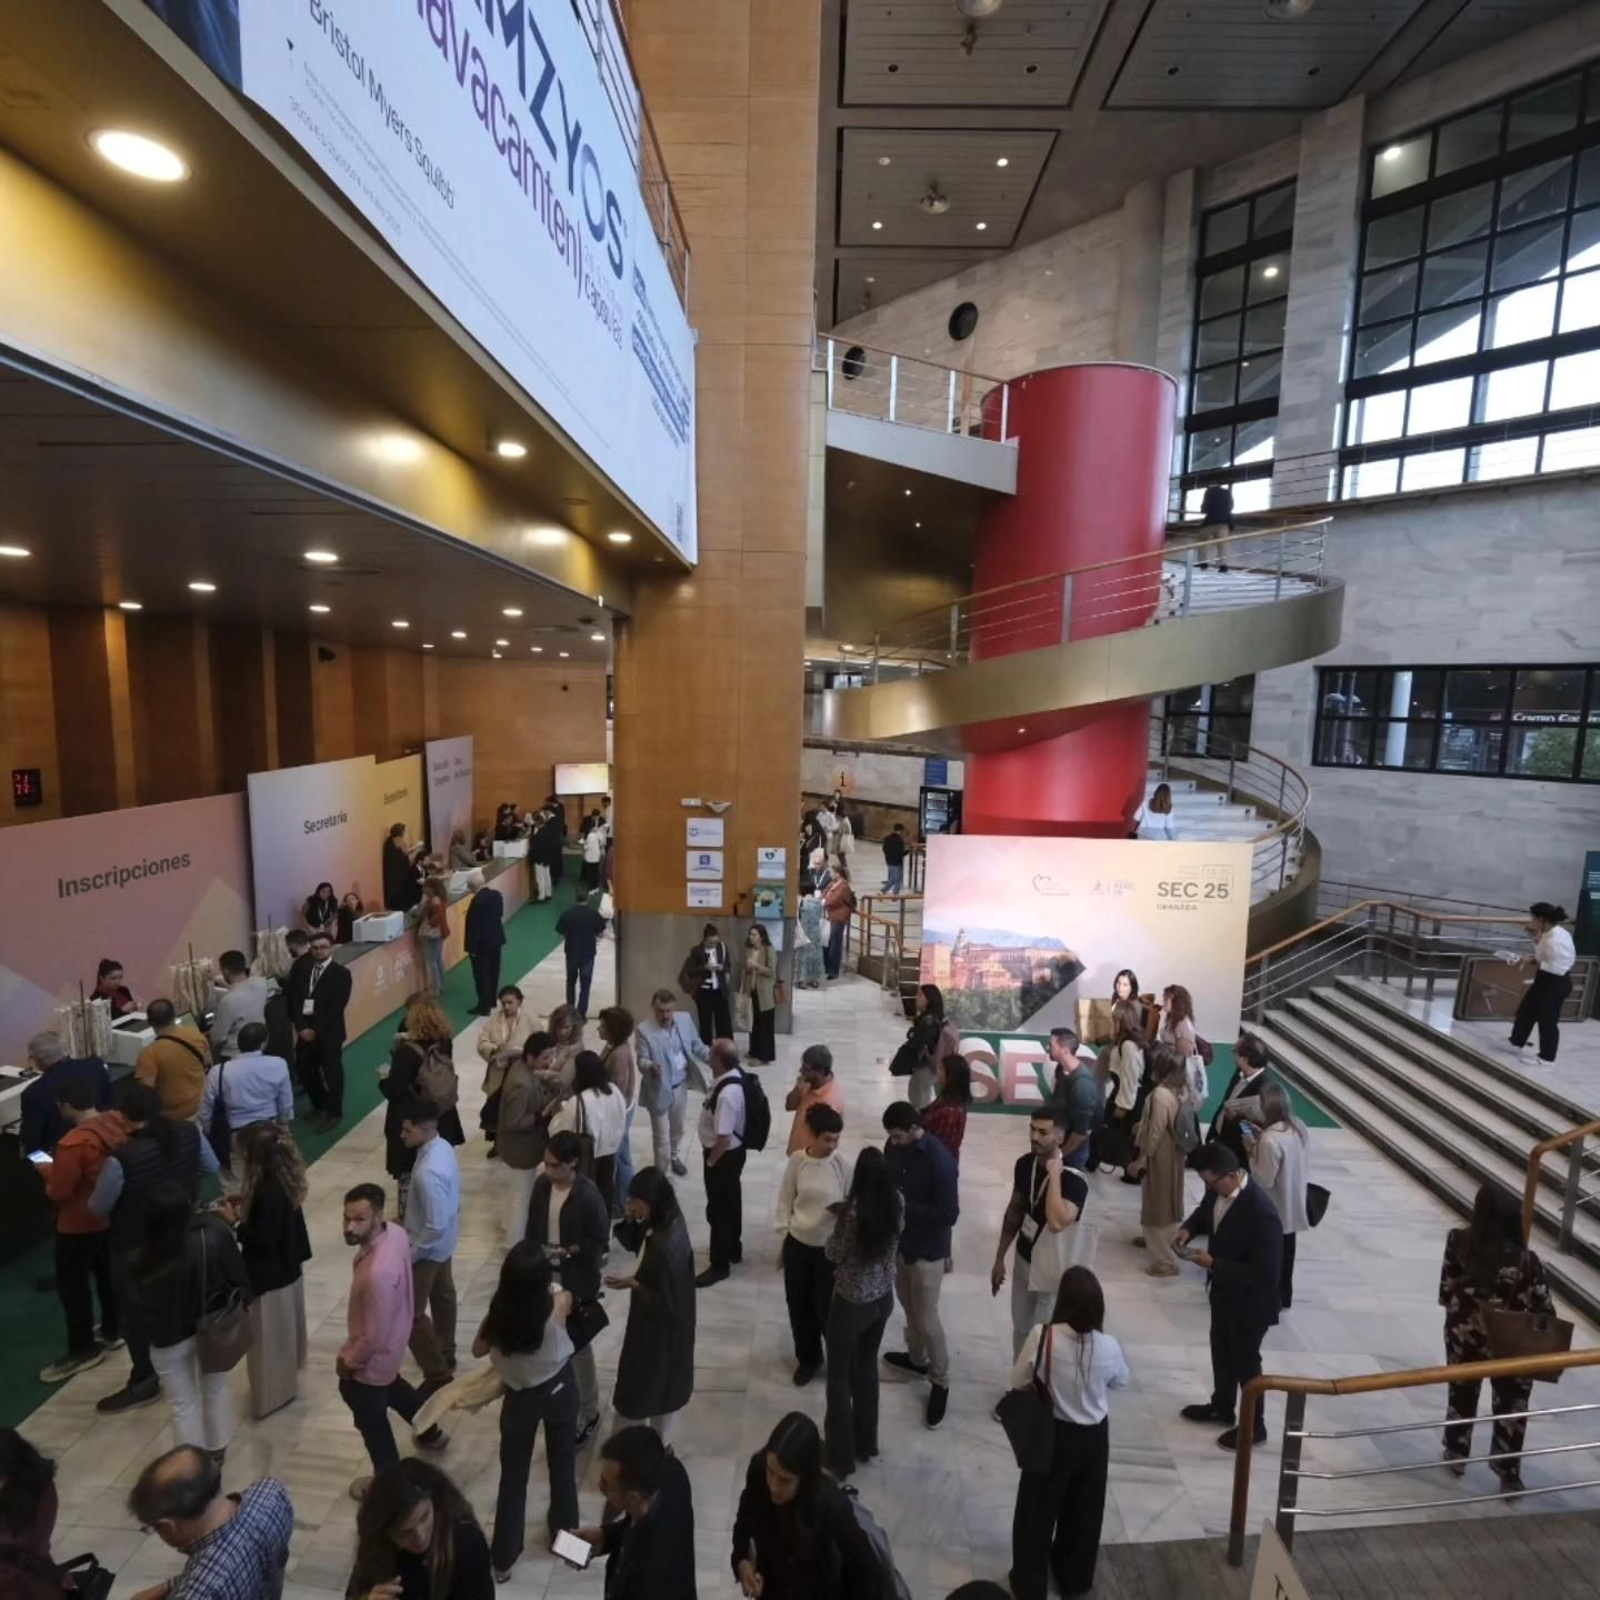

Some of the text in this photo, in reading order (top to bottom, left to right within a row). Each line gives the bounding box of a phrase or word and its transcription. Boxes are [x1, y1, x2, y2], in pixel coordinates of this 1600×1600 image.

[310, 0, 366, 88] Bristol
[367, 67, 413, 153] Myers
[413, 137, 455, 210] Squibb
[57, 853, 191, 899] Inscripciones
[1157, 881, 1229, 899] SEC 25
